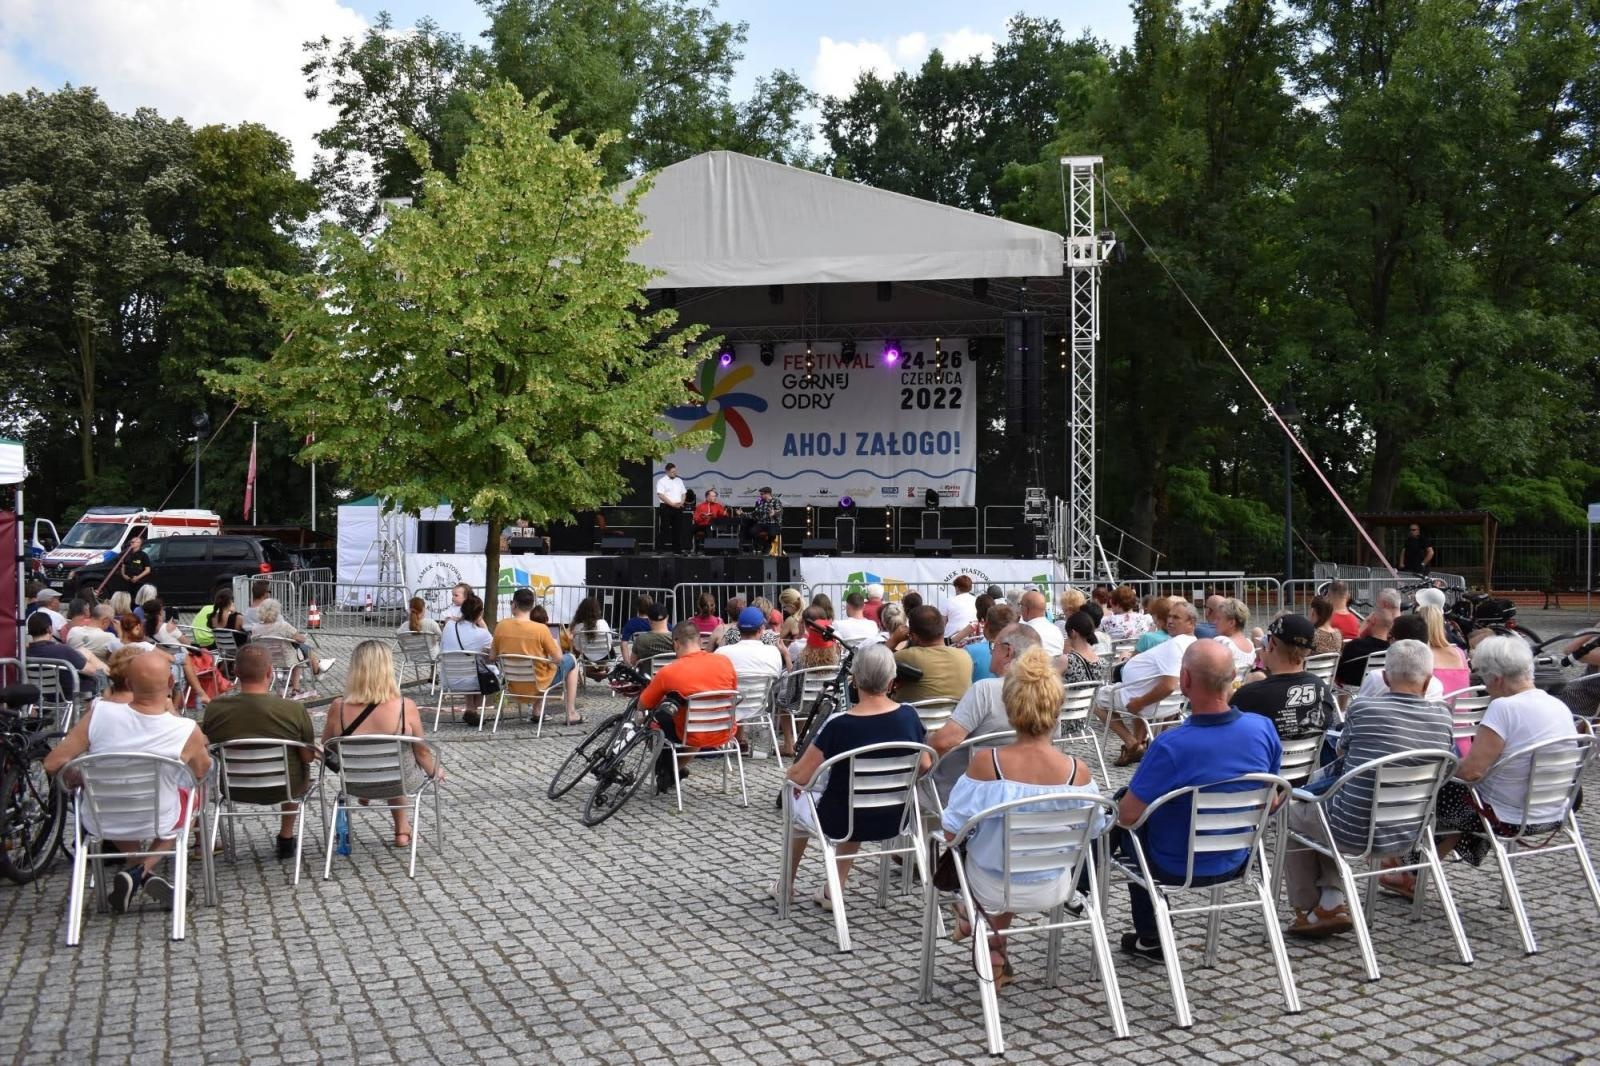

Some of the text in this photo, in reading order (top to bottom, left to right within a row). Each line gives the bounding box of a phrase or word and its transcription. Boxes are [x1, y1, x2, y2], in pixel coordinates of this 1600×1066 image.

[901, 371, 962, 386] CZERWCA
[781, 393, 834, 409] ODRY
[901, 387, 962, 410] 2022
[782, 431, 961, 456] AHOJ ZAŁOGO!
[1287, 685, 1315, 706] 25
